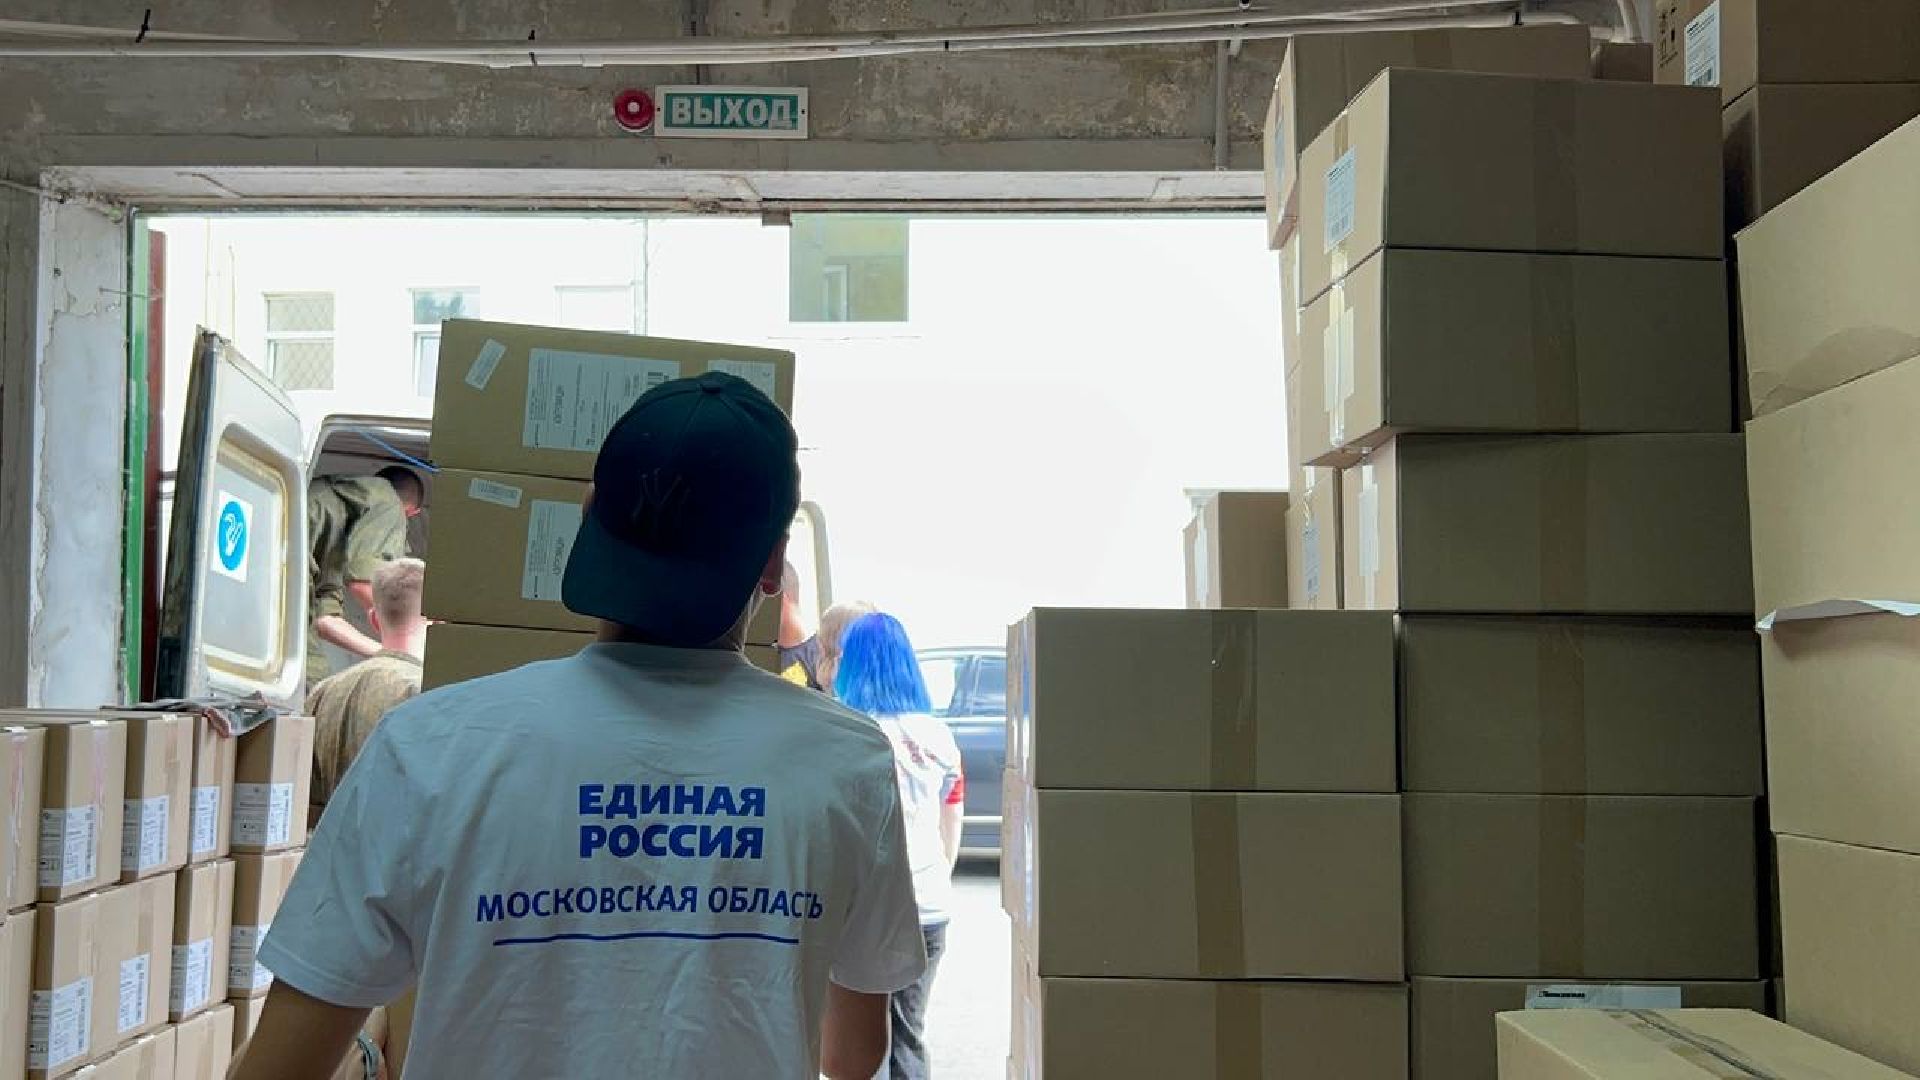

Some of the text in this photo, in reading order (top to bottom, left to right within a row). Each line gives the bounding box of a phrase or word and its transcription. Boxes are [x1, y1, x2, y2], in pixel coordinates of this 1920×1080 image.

[672, 97, 792, 129] ВЫХОД
[579, 783, 766, 819] ЕДИНАЯ
[579, 824, 764, 859] РОССИЯ
[476, 884, 698, 922] МОСКОВСКАЯ
